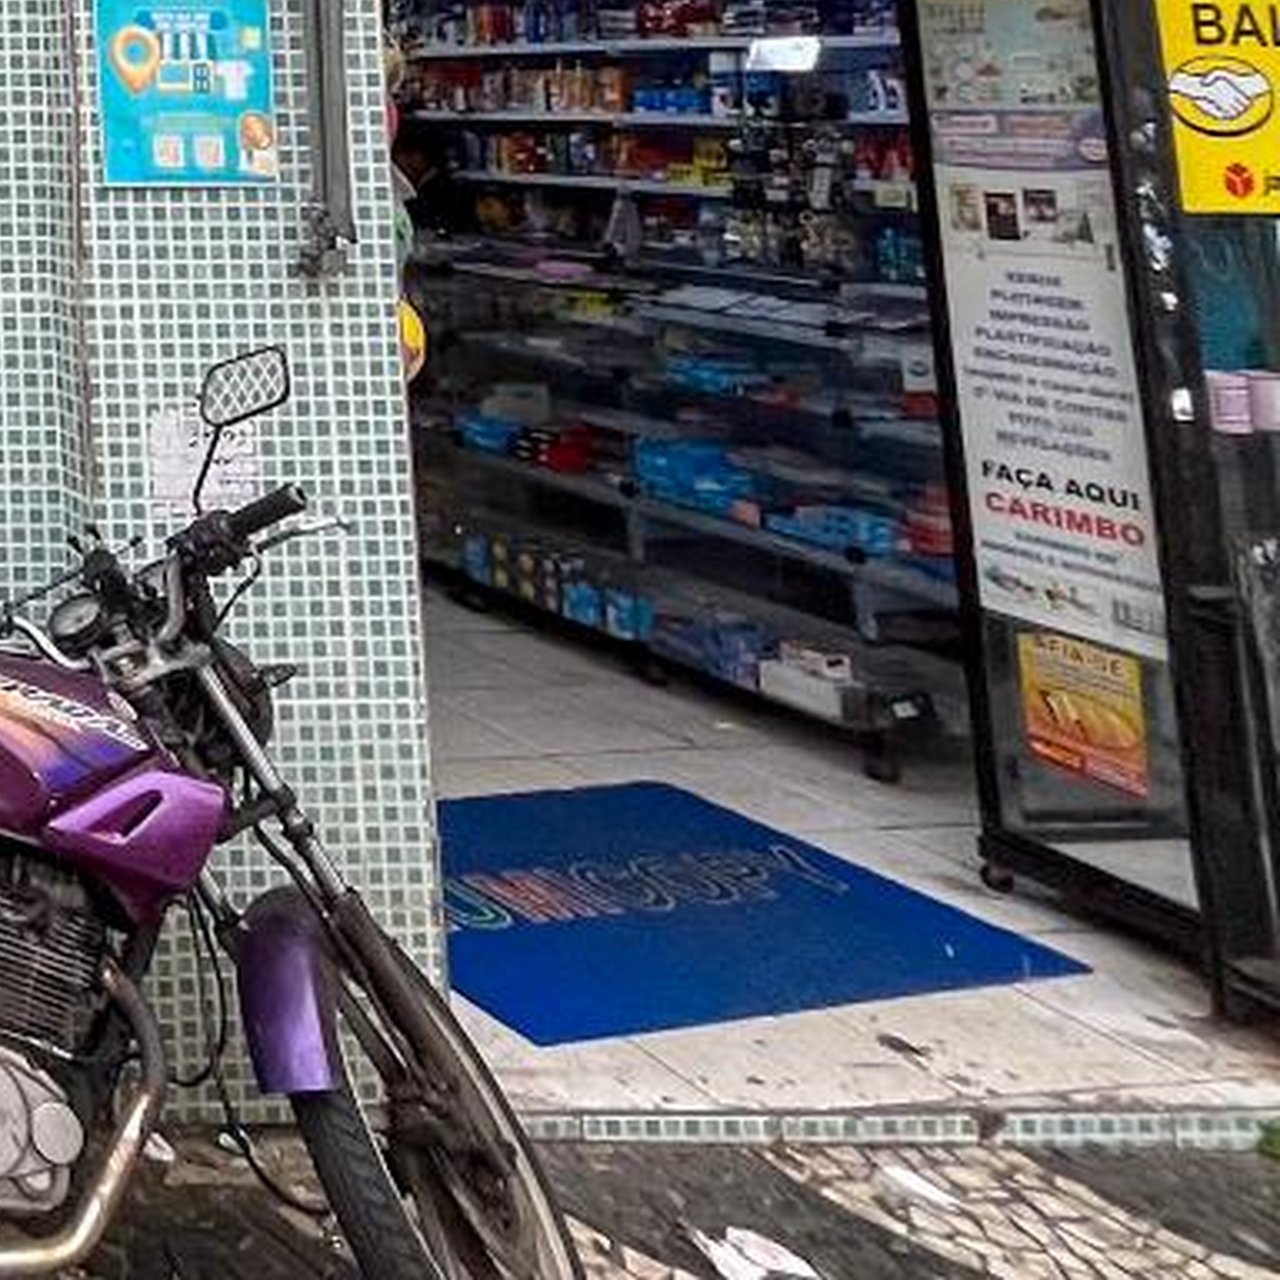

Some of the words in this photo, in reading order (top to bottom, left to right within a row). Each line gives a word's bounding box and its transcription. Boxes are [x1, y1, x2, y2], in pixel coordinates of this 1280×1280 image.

[981, 458, 1054, 491] FAÇA
[1064, 478, 1143, 511] AQUI
[984, 491, 1146, 548] CARIMBO
